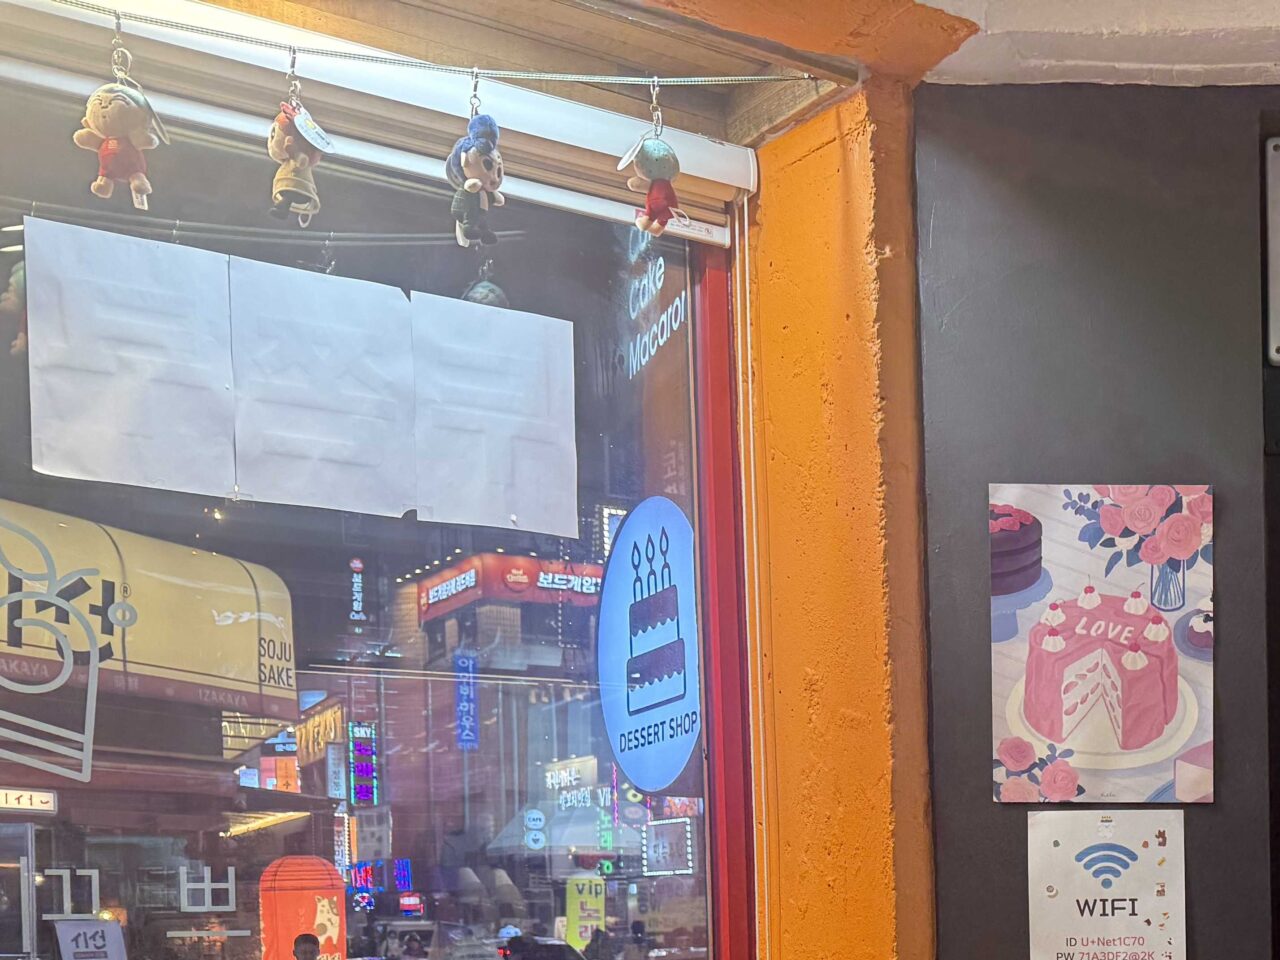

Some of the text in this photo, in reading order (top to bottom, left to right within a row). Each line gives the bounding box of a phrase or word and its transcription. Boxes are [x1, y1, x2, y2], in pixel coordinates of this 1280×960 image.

[629, 257, 665, 319] Cake
[537, 571, 602, 594] 보드게임
[1075, 616, 1135, 645] LOVE
[259, 638, 292, 663] SOJU
[259, 663, 293, 688] SAKE
[198, 689, 248, 706] IZAKAYA
[353, 727, 372, 738] SKY
[619, 711, 699, 753] DESSERT SHOP
[576, 880, 603, 897] vip
[1076, 898, 1139, 917] WIFI
[1066, 936, 1145, 947] ID U+Net1C70
